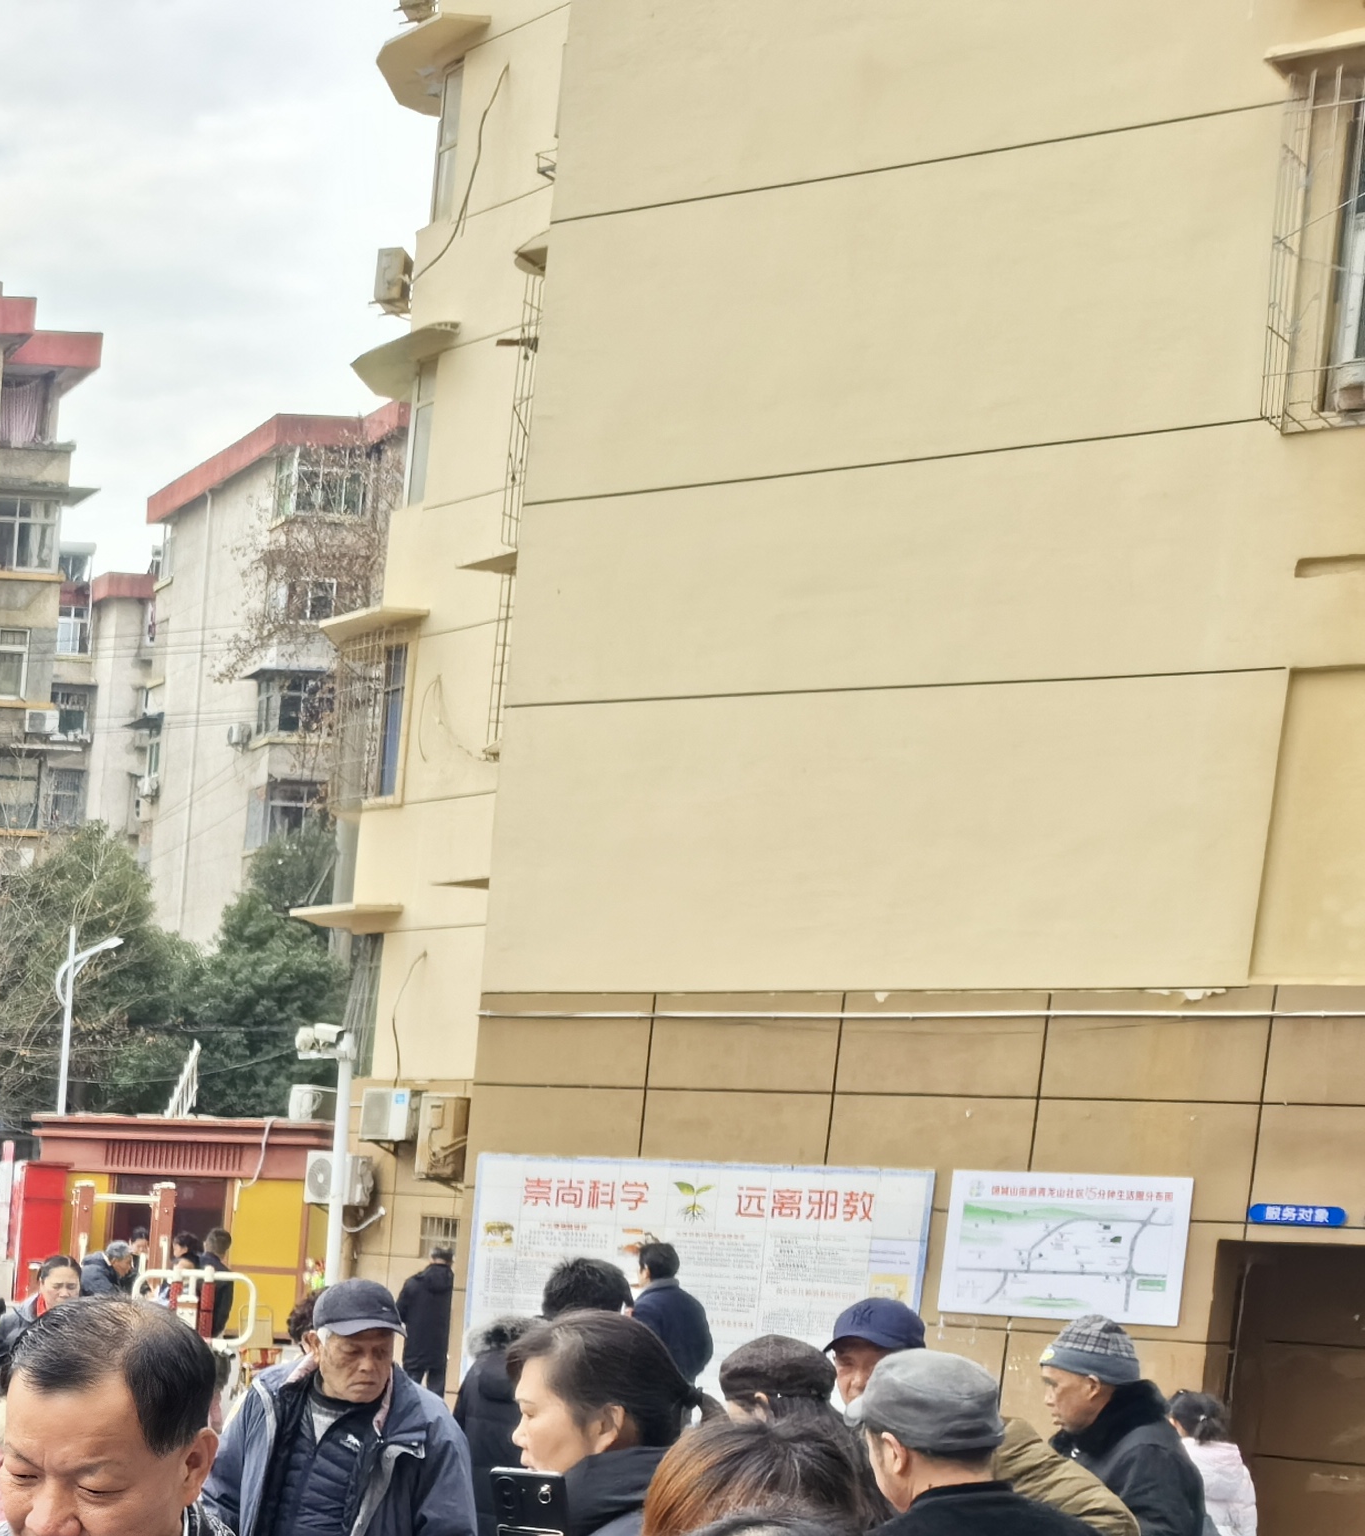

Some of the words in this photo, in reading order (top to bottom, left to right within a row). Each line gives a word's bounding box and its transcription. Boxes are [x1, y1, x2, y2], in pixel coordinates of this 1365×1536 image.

[523, 1176, 649, 1211] 崇尚科学
[735, 1185, 875, 1222] 远离邪教
[1265, 1206, 1329, 1223] 服务对象
